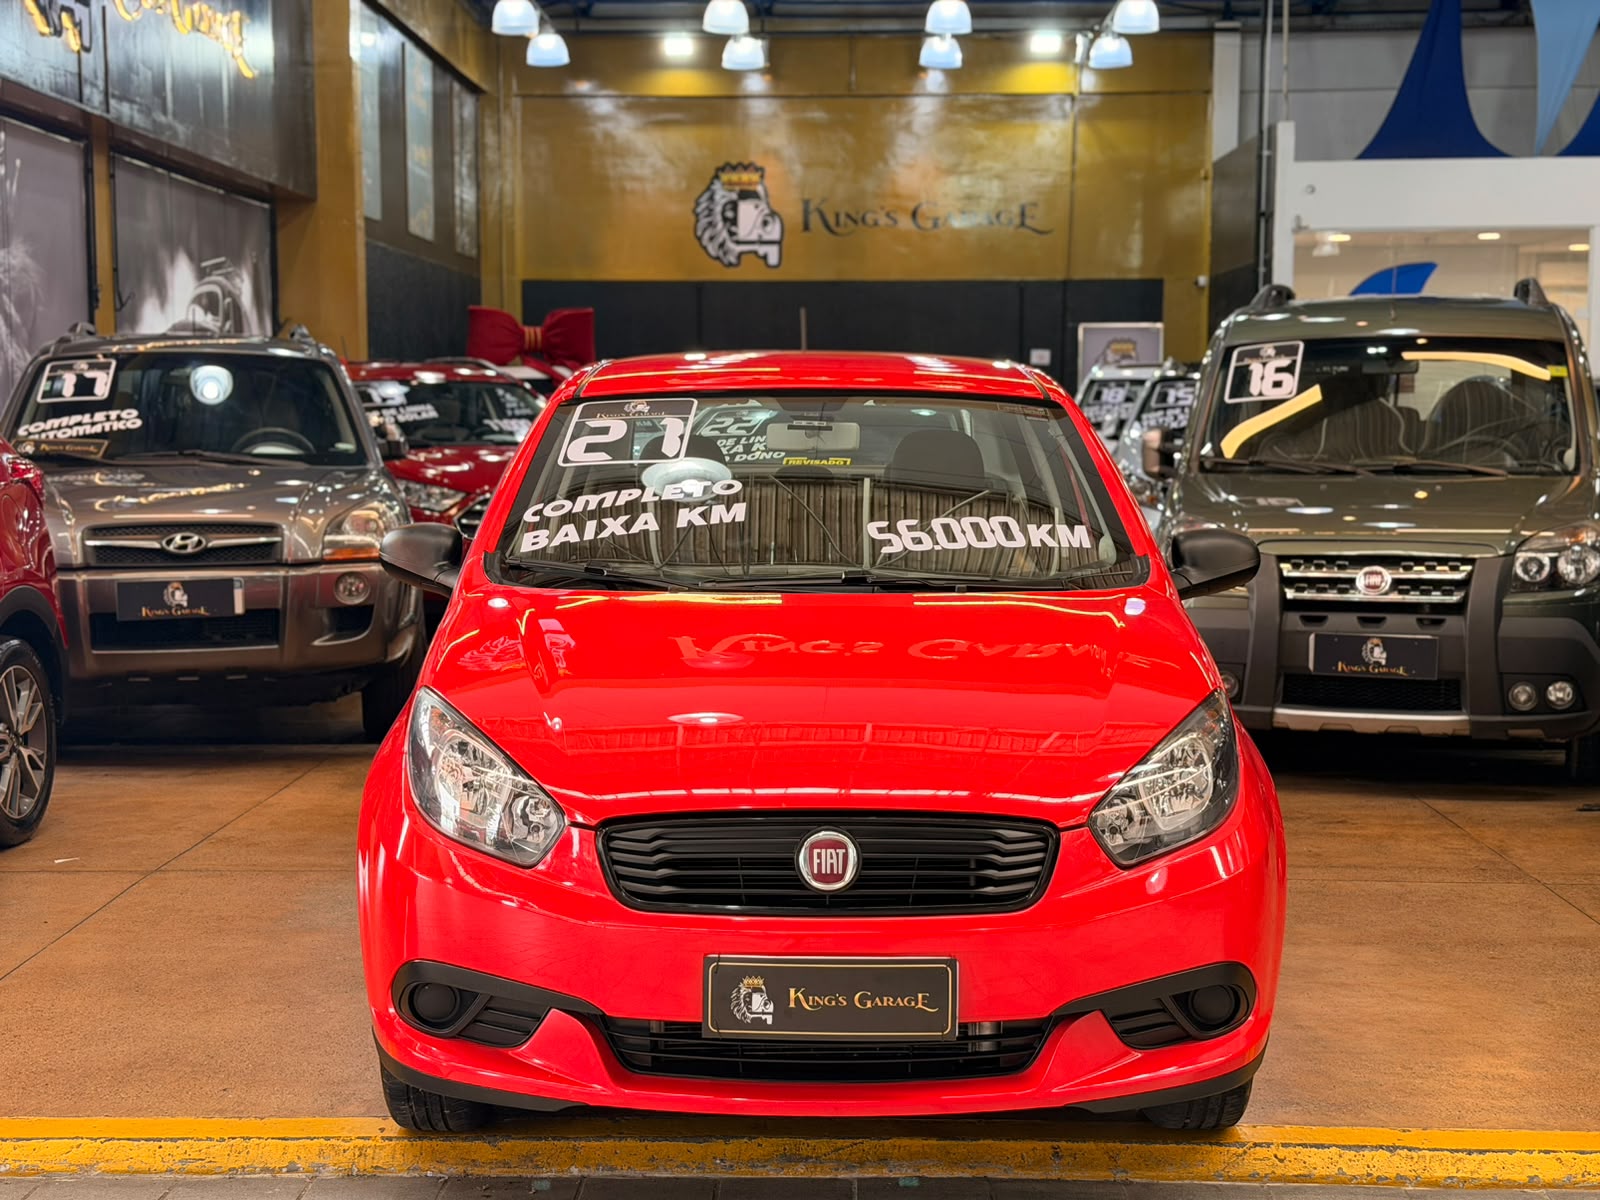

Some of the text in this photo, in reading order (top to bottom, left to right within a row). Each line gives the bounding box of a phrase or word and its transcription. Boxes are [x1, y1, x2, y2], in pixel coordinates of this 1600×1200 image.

[61, 371, 107, 398] 17
[1248, 359, 1295, 397] 16
[18, 408, 139, 437] COMPLETO
[701, 416, 762, 437] 22
[566, 418, 685, 462] 21
[523, 479, 743, 523] COMPLETO
[520, 502, 747, 553] BAIXA KM
[867, 515, 1092, 554] 56.000 KM
[813, 848, 846, 874] FIAT
[788, 987, 940, 1013] KING'S GARAGE
